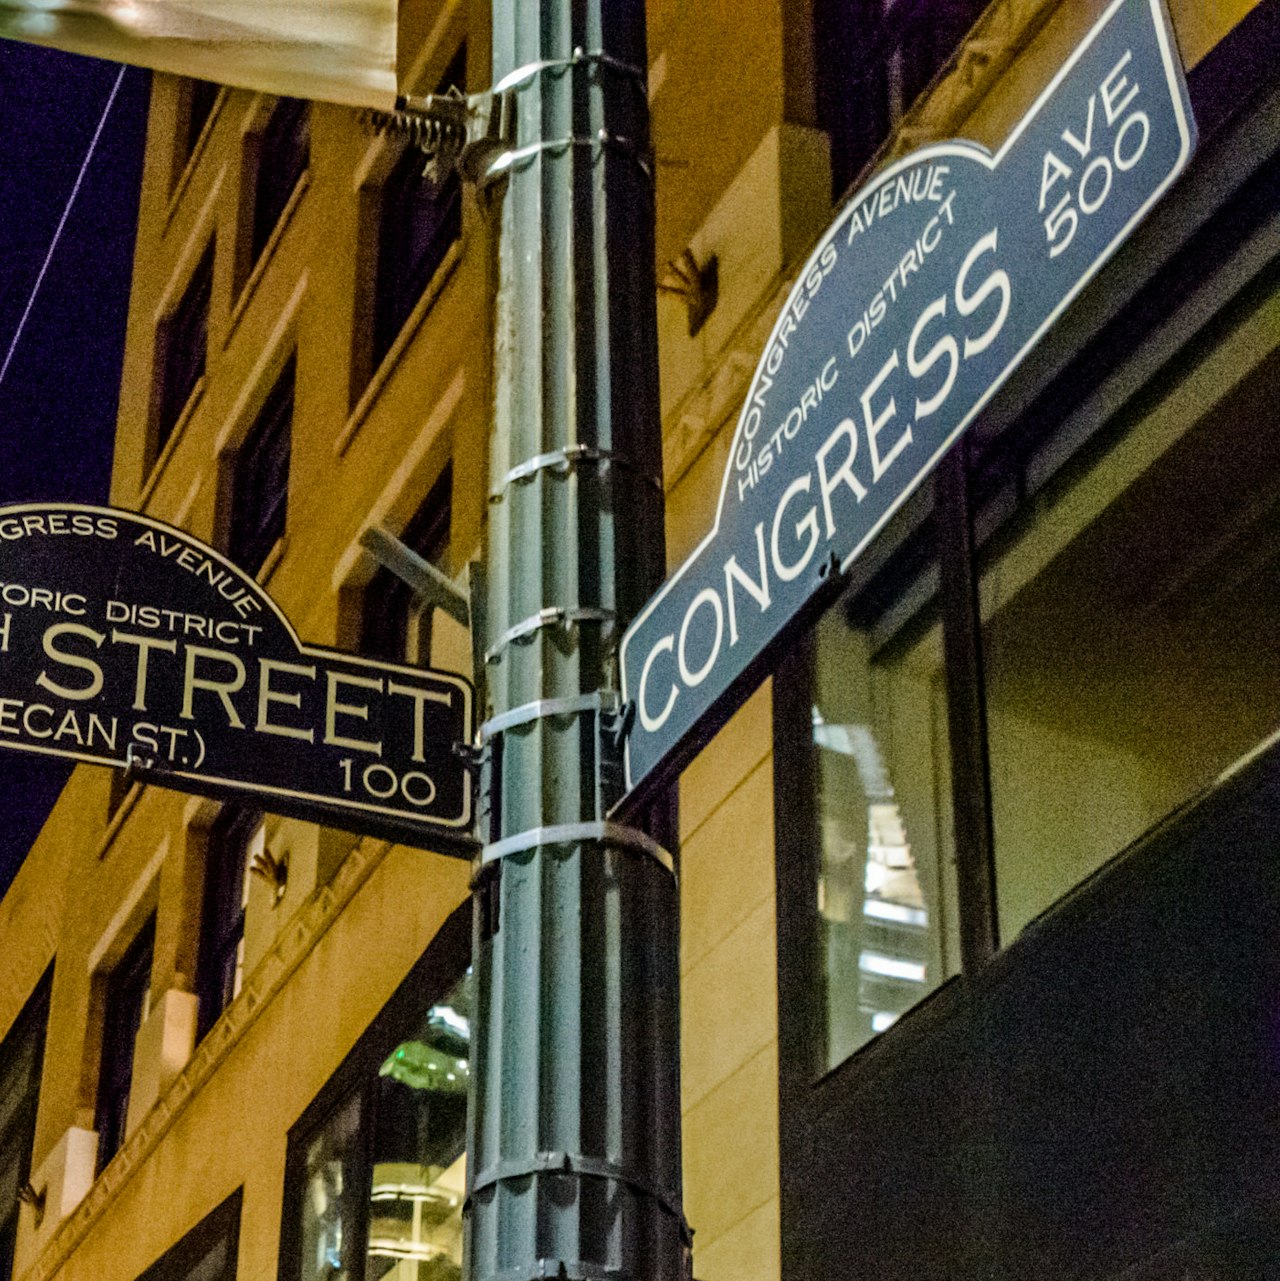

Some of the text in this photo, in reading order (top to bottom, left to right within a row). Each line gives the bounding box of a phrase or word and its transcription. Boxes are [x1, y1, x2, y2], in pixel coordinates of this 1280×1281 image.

[1044, 111, 1150, 258] 500
[735, 165, 950, 471] CONGRESS AVENUE
[737, 190, 957, 502] HISTORIC DISTRICT
[638, 50, 1140, 733] CONGRESS AVE
[106, 600, 263, 646] DISTRICT
[134, 529, 262, 619] AVENUE
[35, 622, 451, 762] STREET
[132, 722, 206, 768] ST.)
[339, 759, 436, 806] 100
